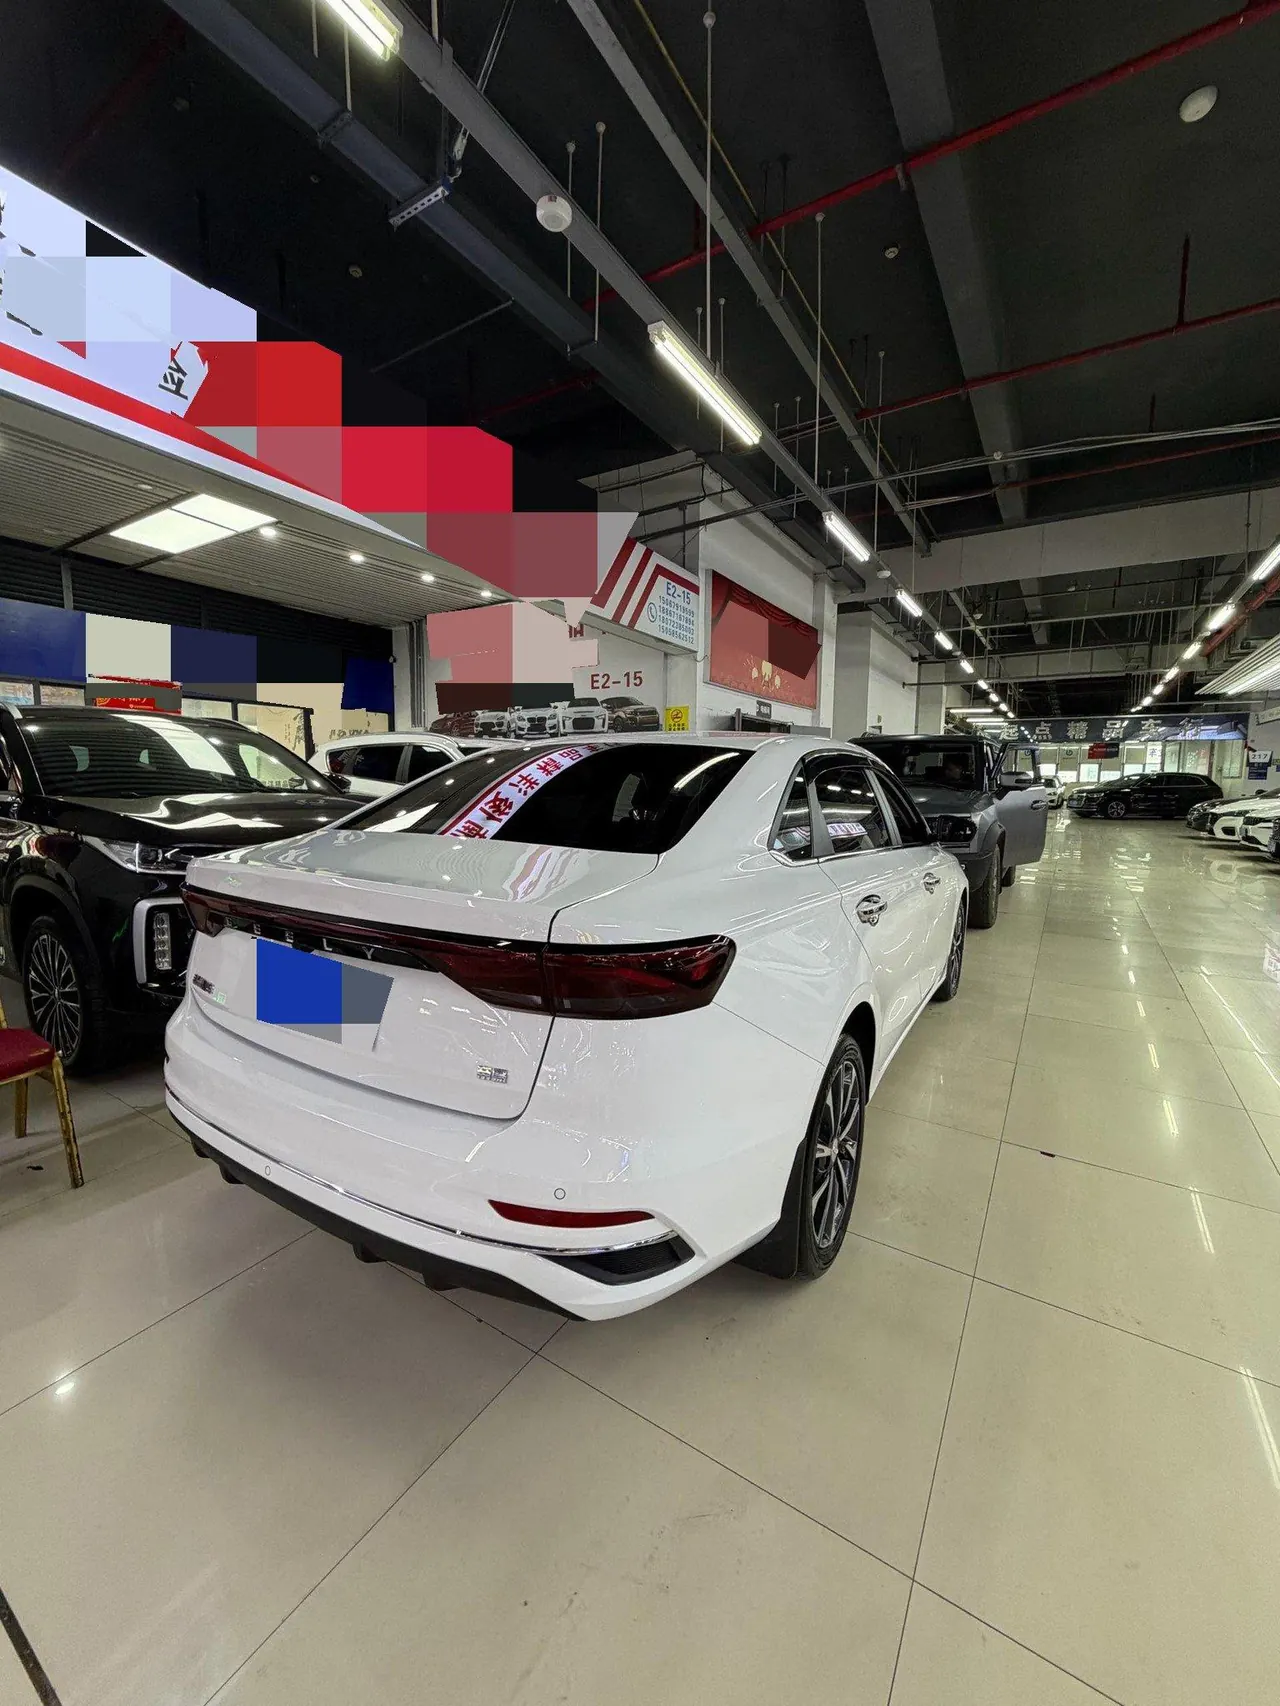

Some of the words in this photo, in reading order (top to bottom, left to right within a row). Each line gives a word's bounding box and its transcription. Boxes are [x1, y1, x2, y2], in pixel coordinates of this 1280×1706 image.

[666, 581, 691, 605] E2-15
[590, 670, 643, 690] E2-15
[998, 717, 1204, 740] 起点精品车行
